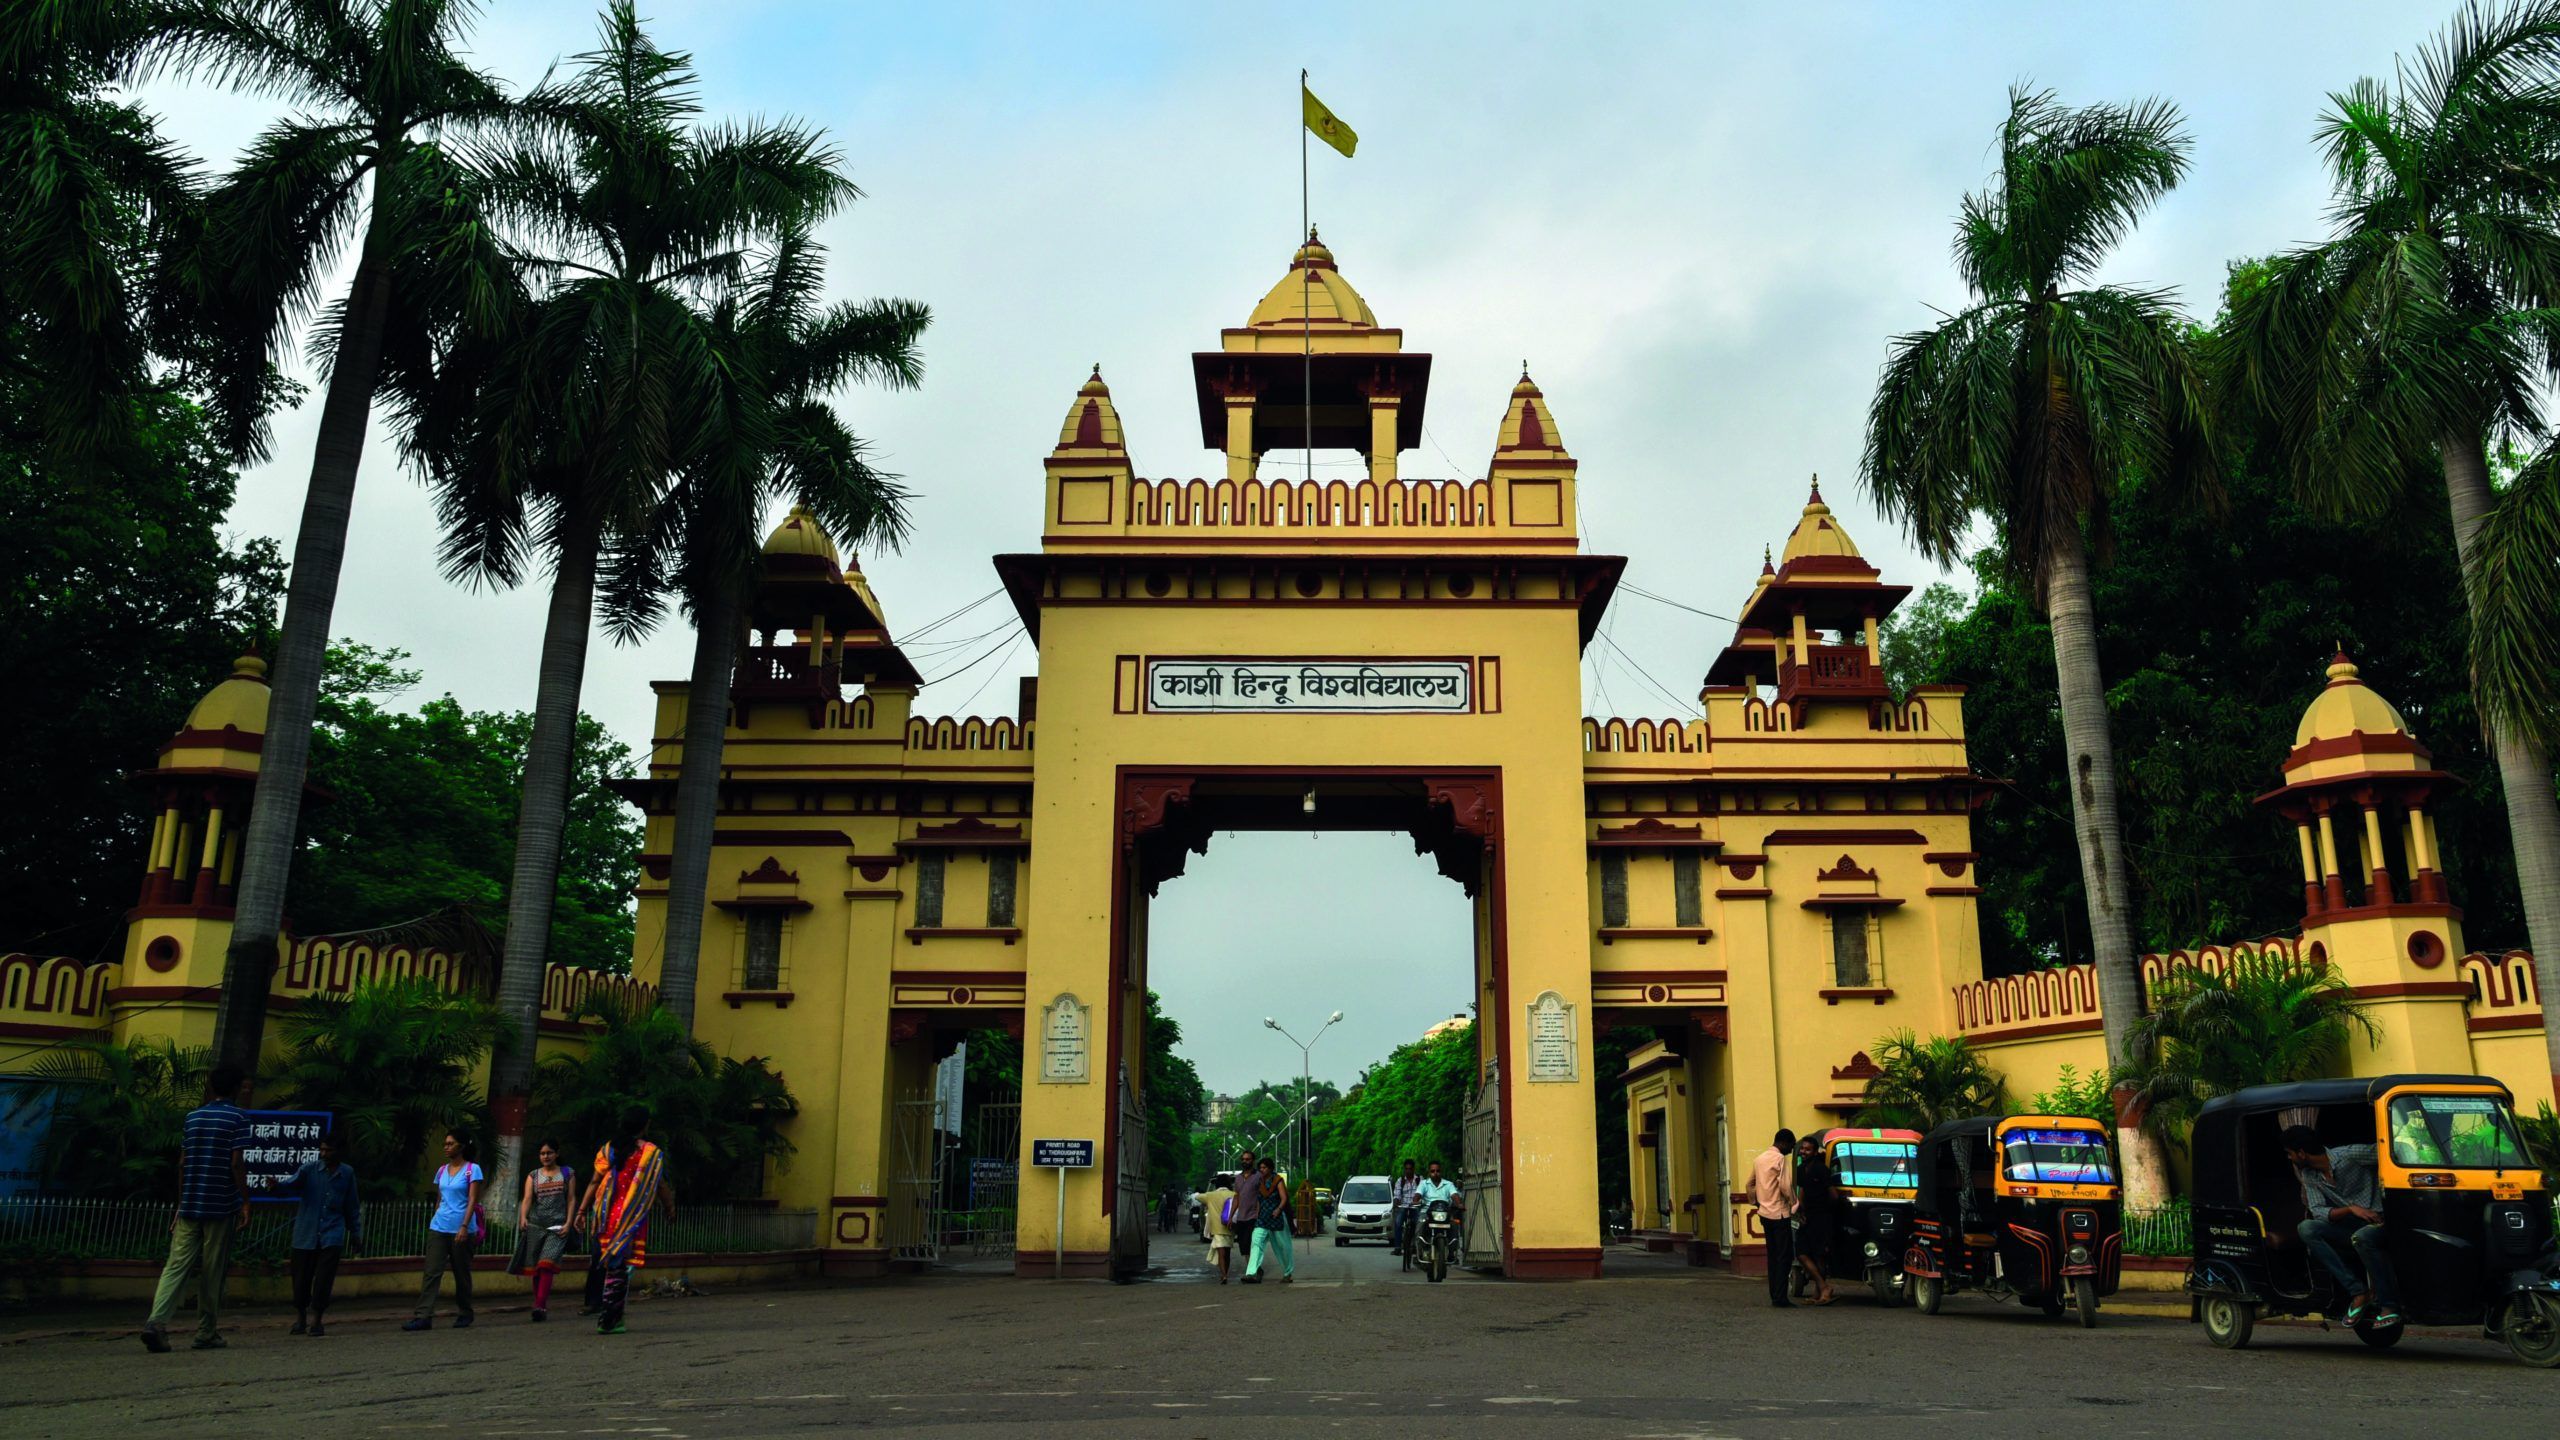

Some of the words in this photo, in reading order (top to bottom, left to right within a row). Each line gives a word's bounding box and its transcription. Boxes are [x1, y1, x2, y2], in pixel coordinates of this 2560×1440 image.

[1159, 667, 1223, 697] काशी
[1231, 667, 1293, 704] हिन्दू
[1297, 667, 1460, 698] विश्वविद्यालय
[255, 1122, 280, 1141] वाहनों
[283, 1125, 297, 1139] पर
[298, 1122, 309, 1141] दो
[310, 1122, 320, 1140] से
